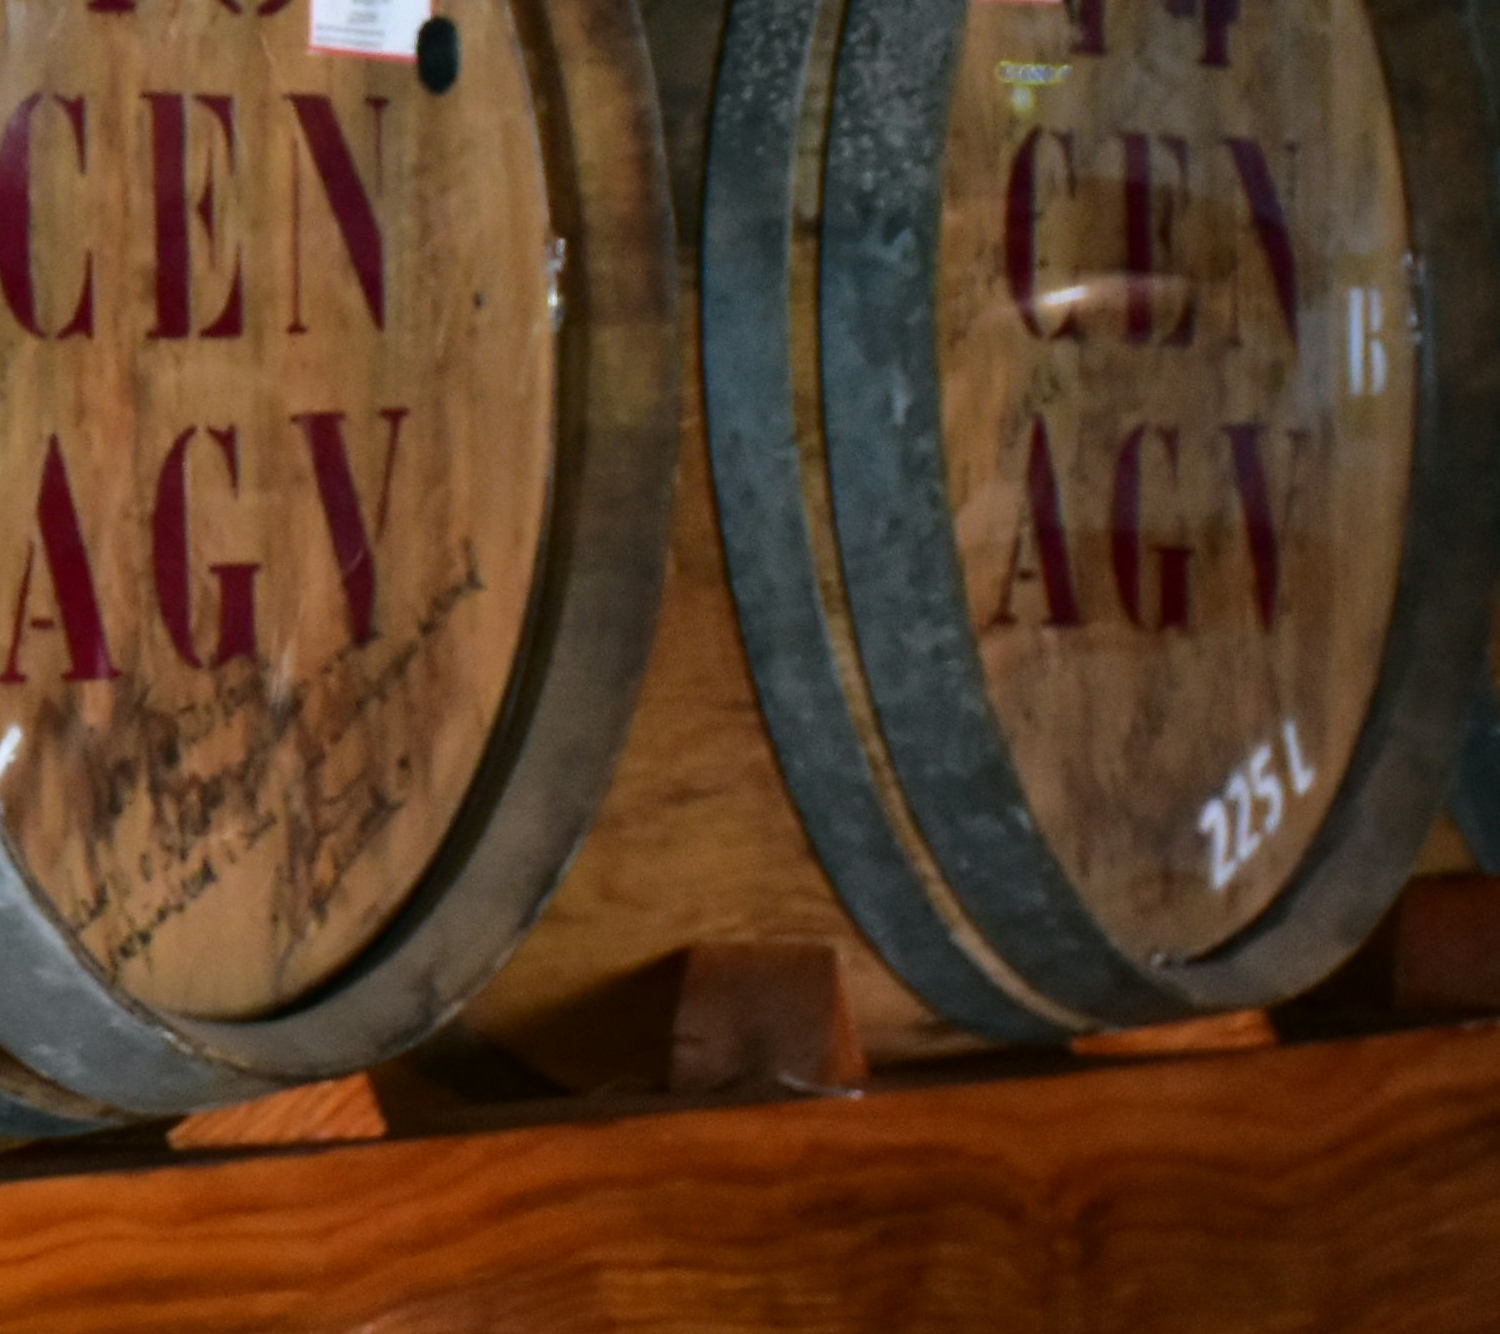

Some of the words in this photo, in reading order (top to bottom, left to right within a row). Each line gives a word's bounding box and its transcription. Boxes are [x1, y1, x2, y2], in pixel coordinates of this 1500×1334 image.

[1005, 126, 1298, 348] CEN
[980, 411, 1327, 636] AGV
[1198, 742, 1284, 891] 225
[1282, 719, 1317, 797] L
